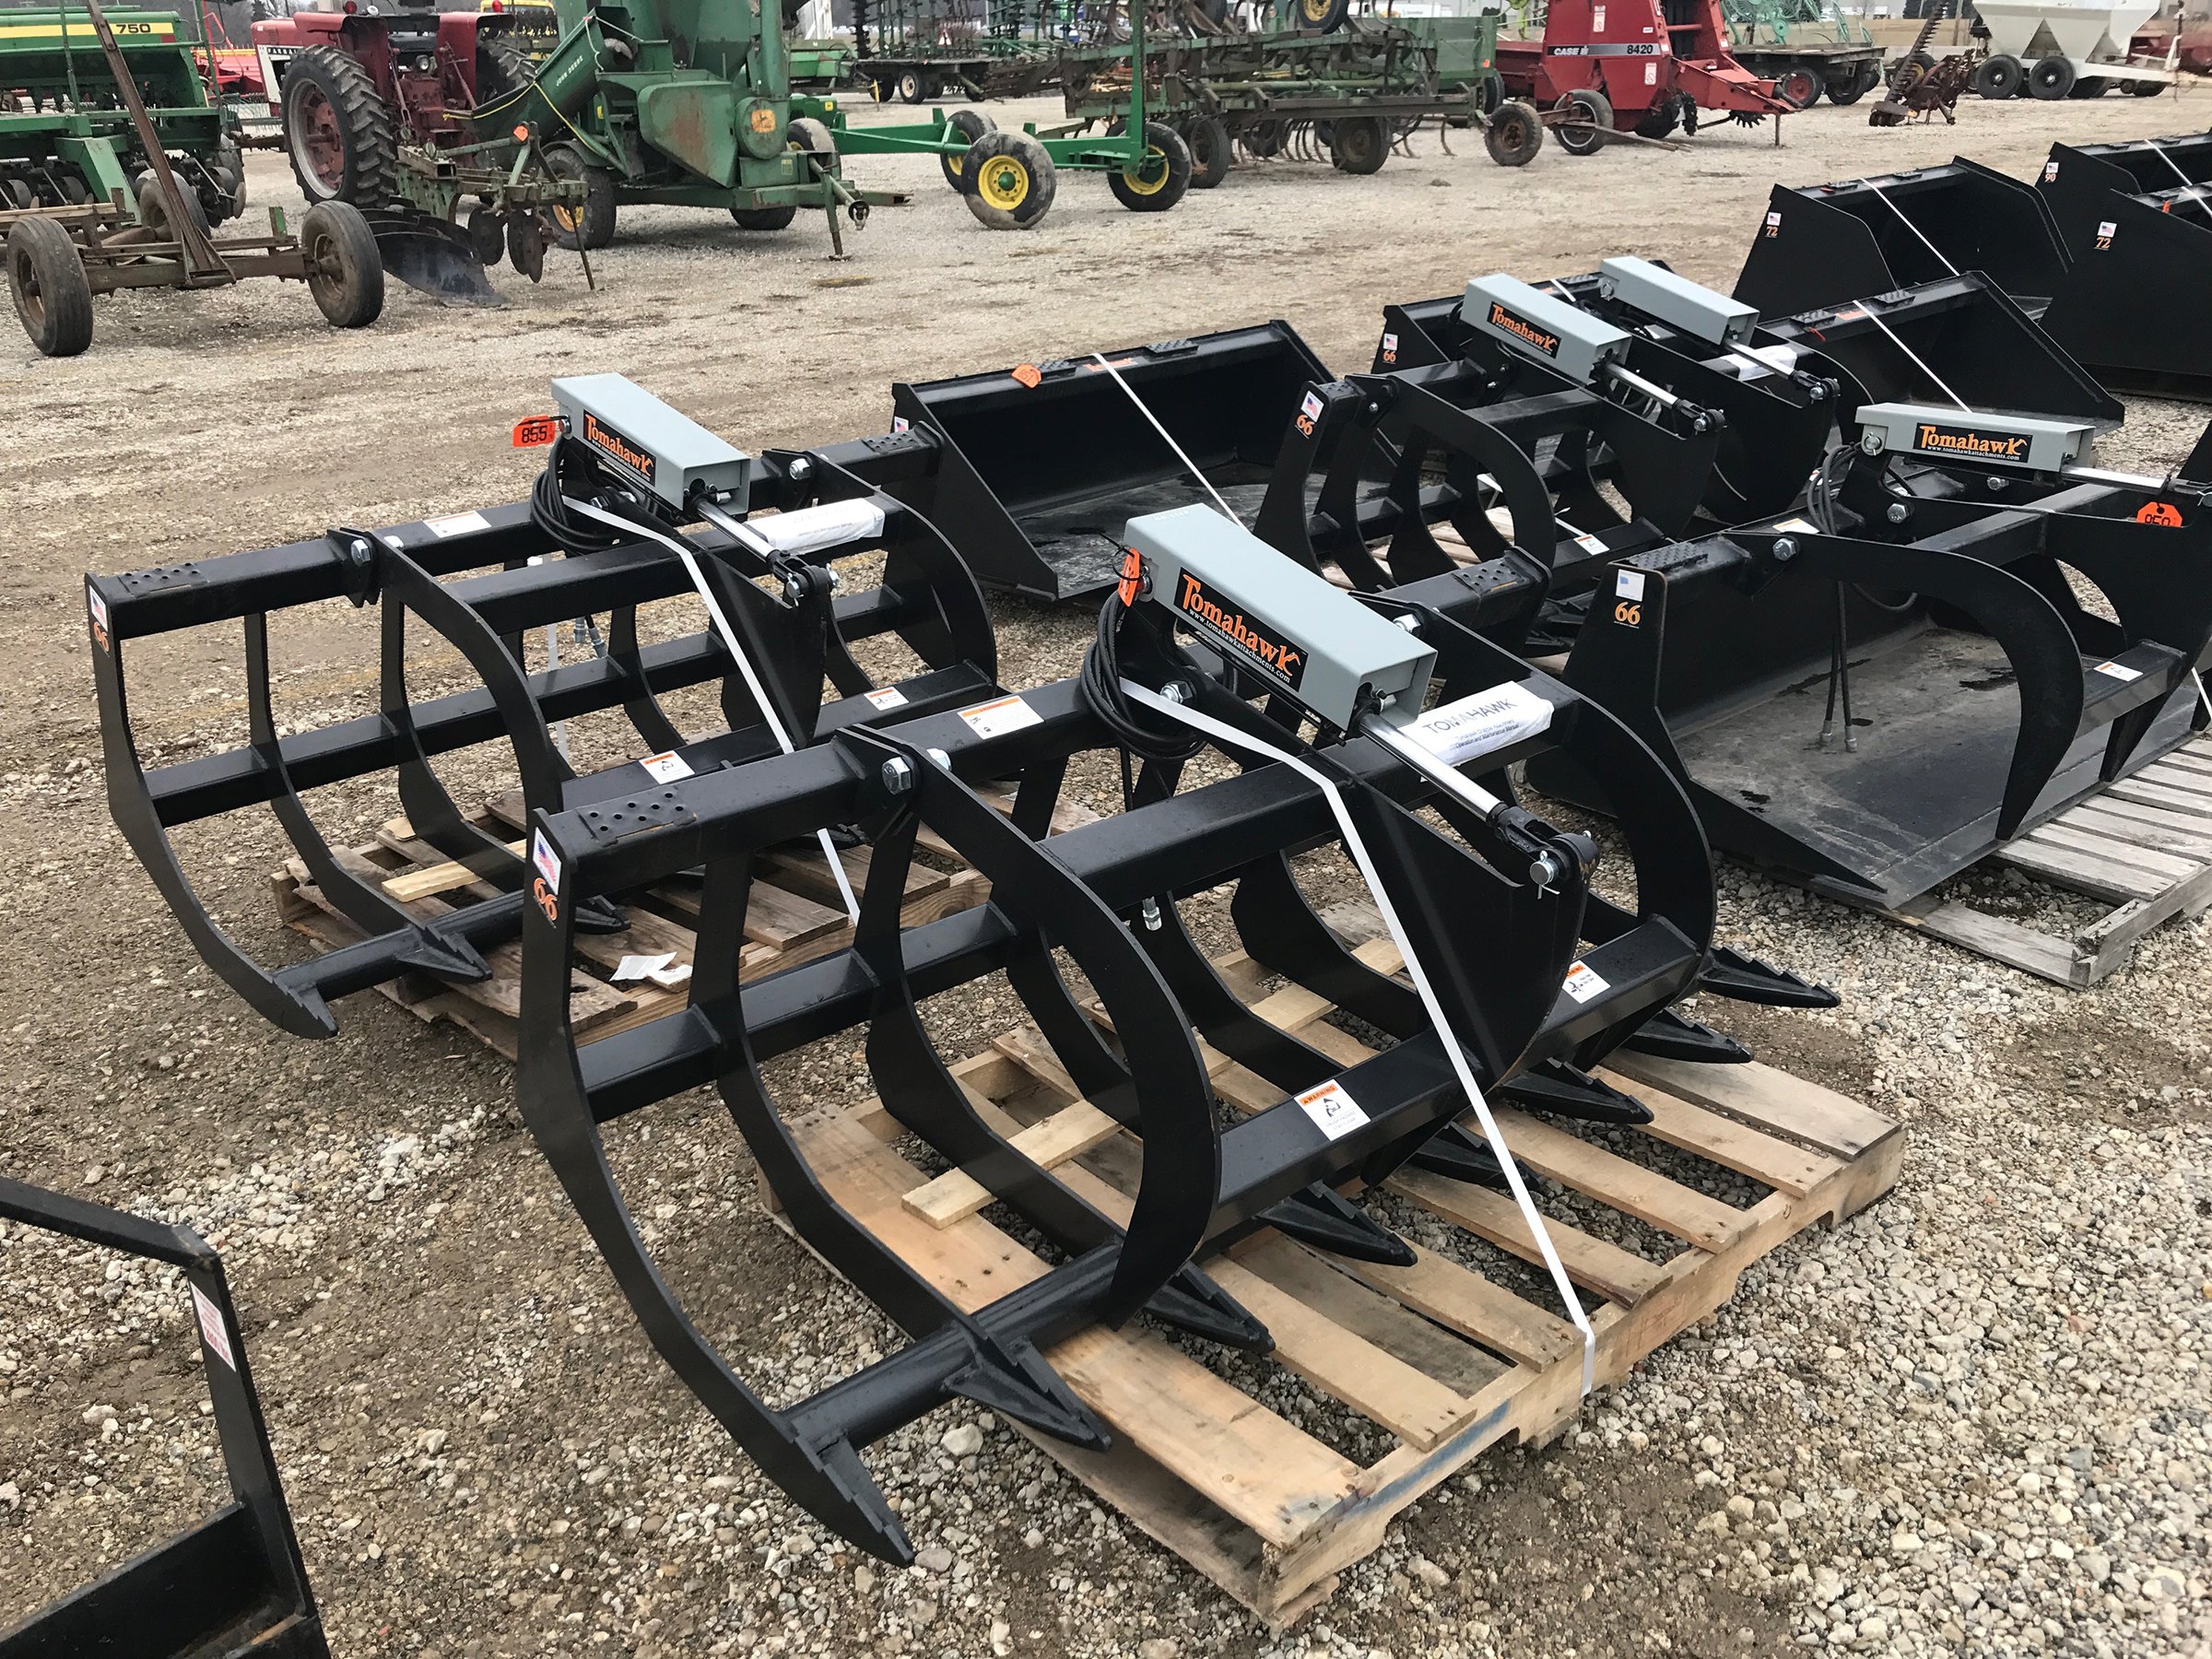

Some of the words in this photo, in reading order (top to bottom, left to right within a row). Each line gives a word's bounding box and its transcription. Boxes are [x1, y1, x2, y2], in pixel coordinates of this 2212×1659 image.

[116, 23, 150, 34] 750
[1627, 44, 1653, 54] 8420
[2045, 172, 2056, 182] 90
[1766, 226, 1779, 237] 72
[2095, 237, 2112, 249] 72
[1490, 304, 1558, 352] Tomahawk
[1382, 350, 1396, 362] 66
[522, 425, 547, 443] 855
[1297, 414, 1315, 436] 66
[585, 413, 654, 477] Tomahawk
[1920, 425, 2028, 456] Tomahawk
[1927, 445, 2020, 461] www.tomahawkattachments.com
[1615, 601, 1641, 625] 66
[1182, 573, 1301, 677] Tomahawk
[93, 621, 110, 653] 66
[1189, 608, 1291, 684] www.tomahawkattachments.com
[1423, 699, 1518, 734] TOMAHAWK
[533, 877, 559, 921] 66
[1308, 1085, 1336, 1102] WARNING
